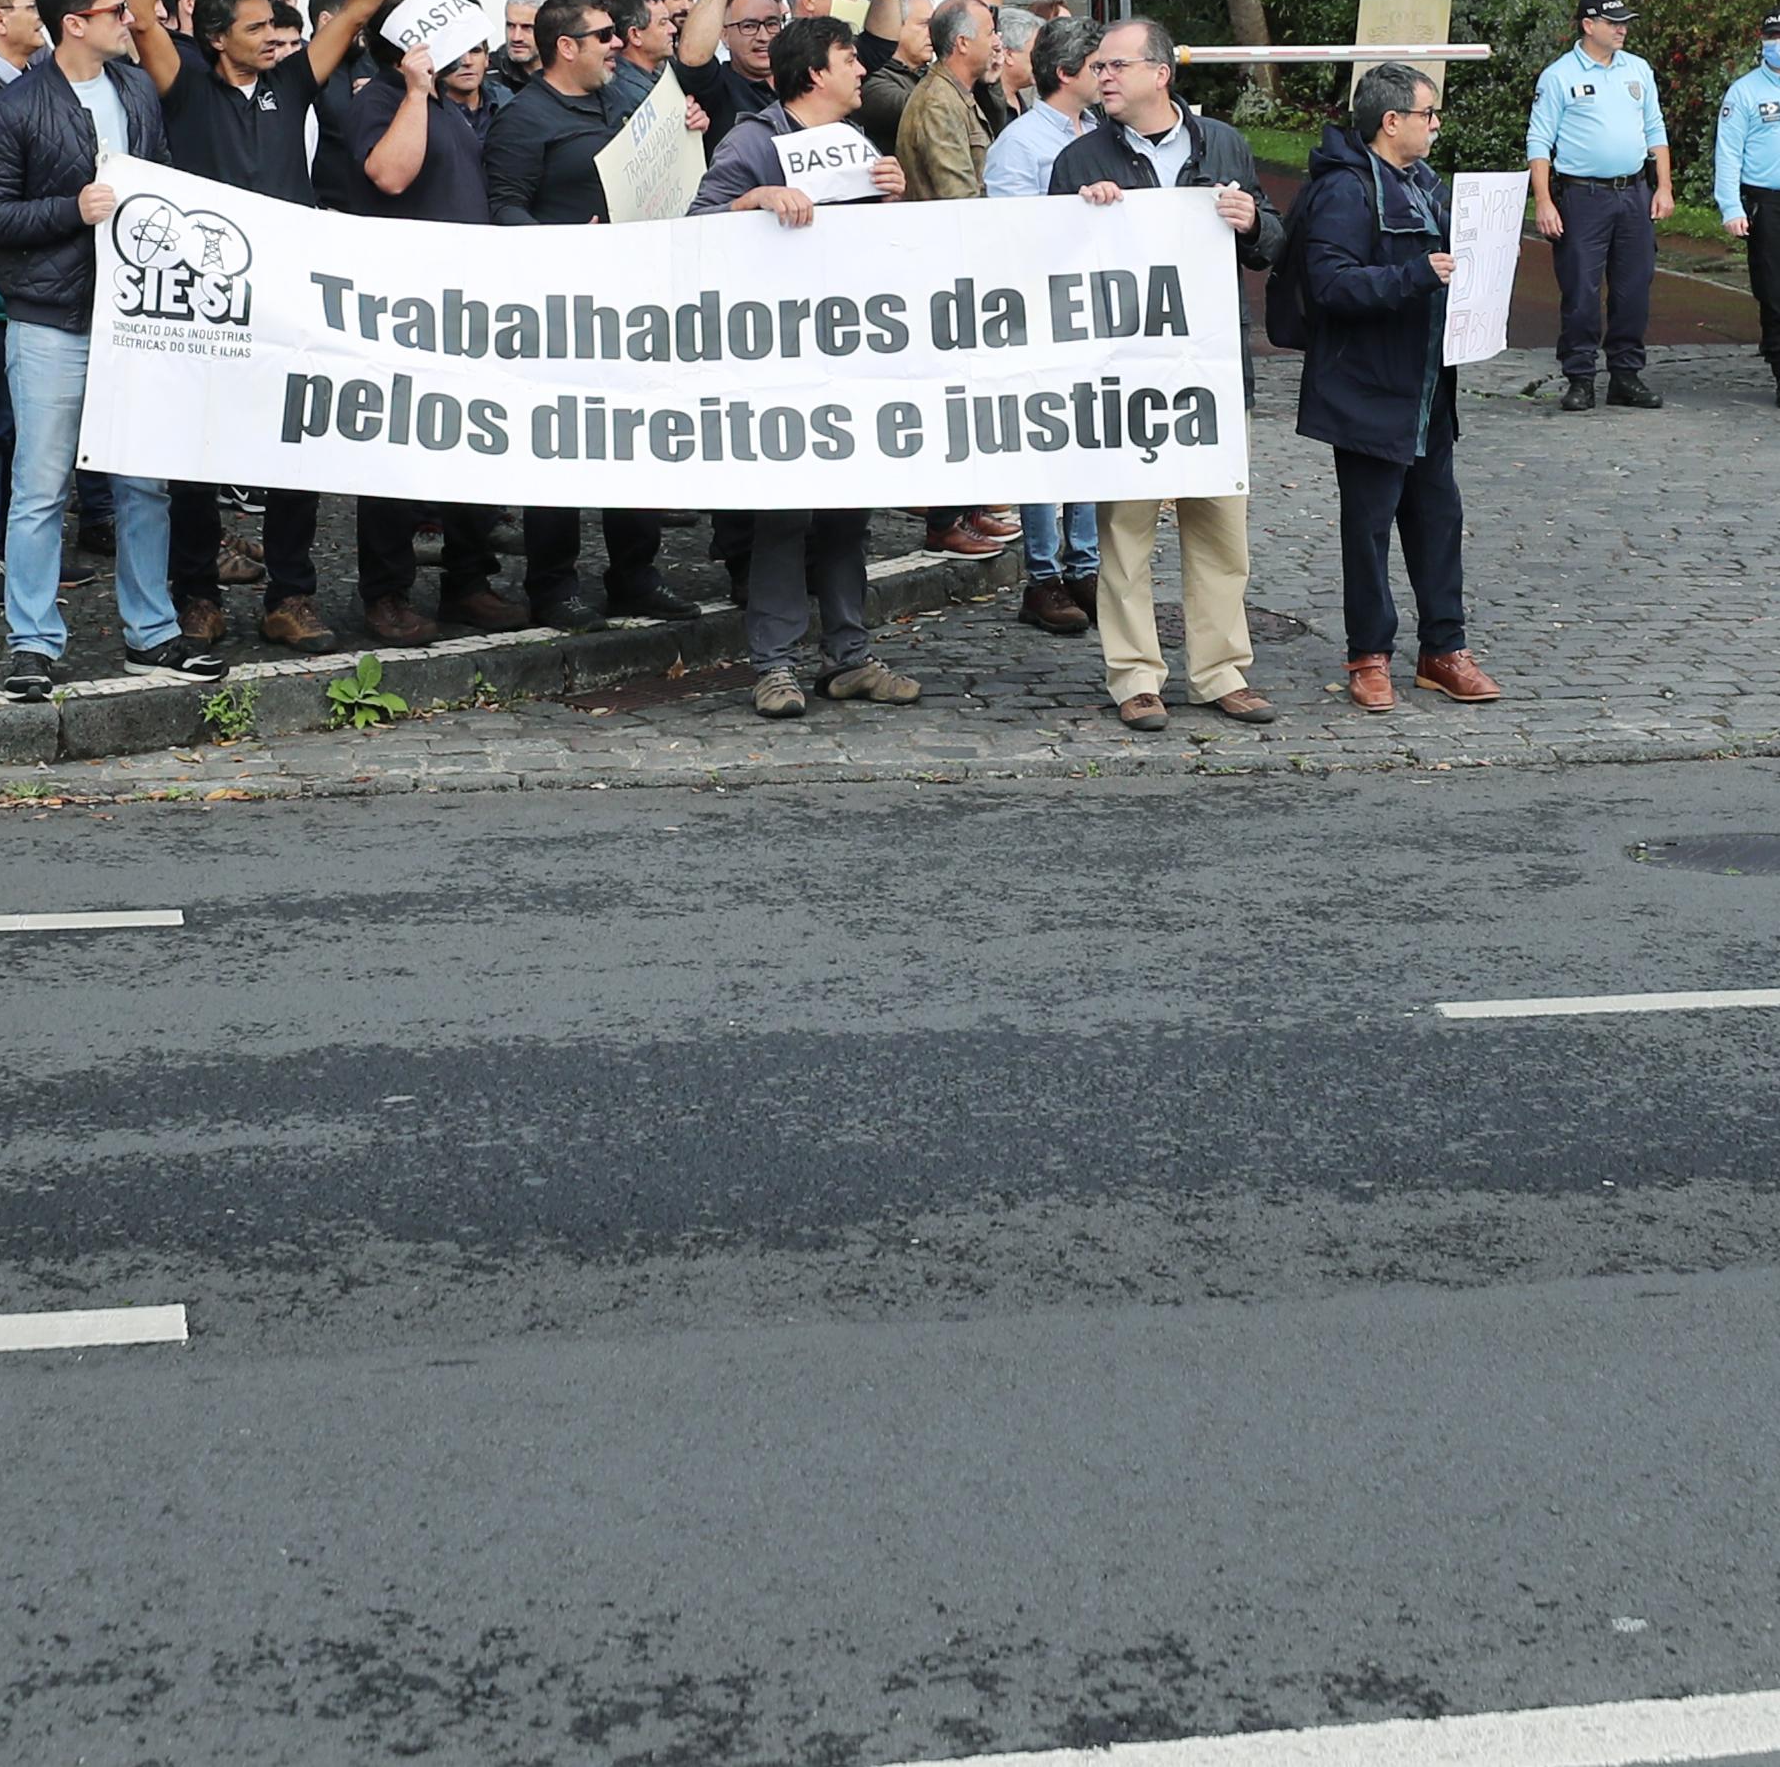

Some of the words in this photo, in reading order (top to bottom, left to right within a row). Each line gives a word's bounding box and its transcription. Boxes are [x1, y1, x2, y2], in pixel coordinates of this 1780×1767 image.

[632, 99, 657, 147] EDA
[787, 143, 877, 175] BASTA
[309, 271, 910, 362] Trabalhadores
[929, 277, 1026, 350] da
[1047, 264, 1190, 344] EDA
[164, 325, 185, 339] DAS
[187, 325, 253, 344] INDÚSTRIAS
[170, 342, 185, 354] DO
[187, 343, 207, 356] SUL
[210, 345, 217, 356] E
[220, 346, 252, 359] ILHAS
[280, 371, 510, 456] pelos
[530, 395, 856, 463] direitos
[876, 401, 923, 458] e
[943, 376, 1219, 464] justiça
